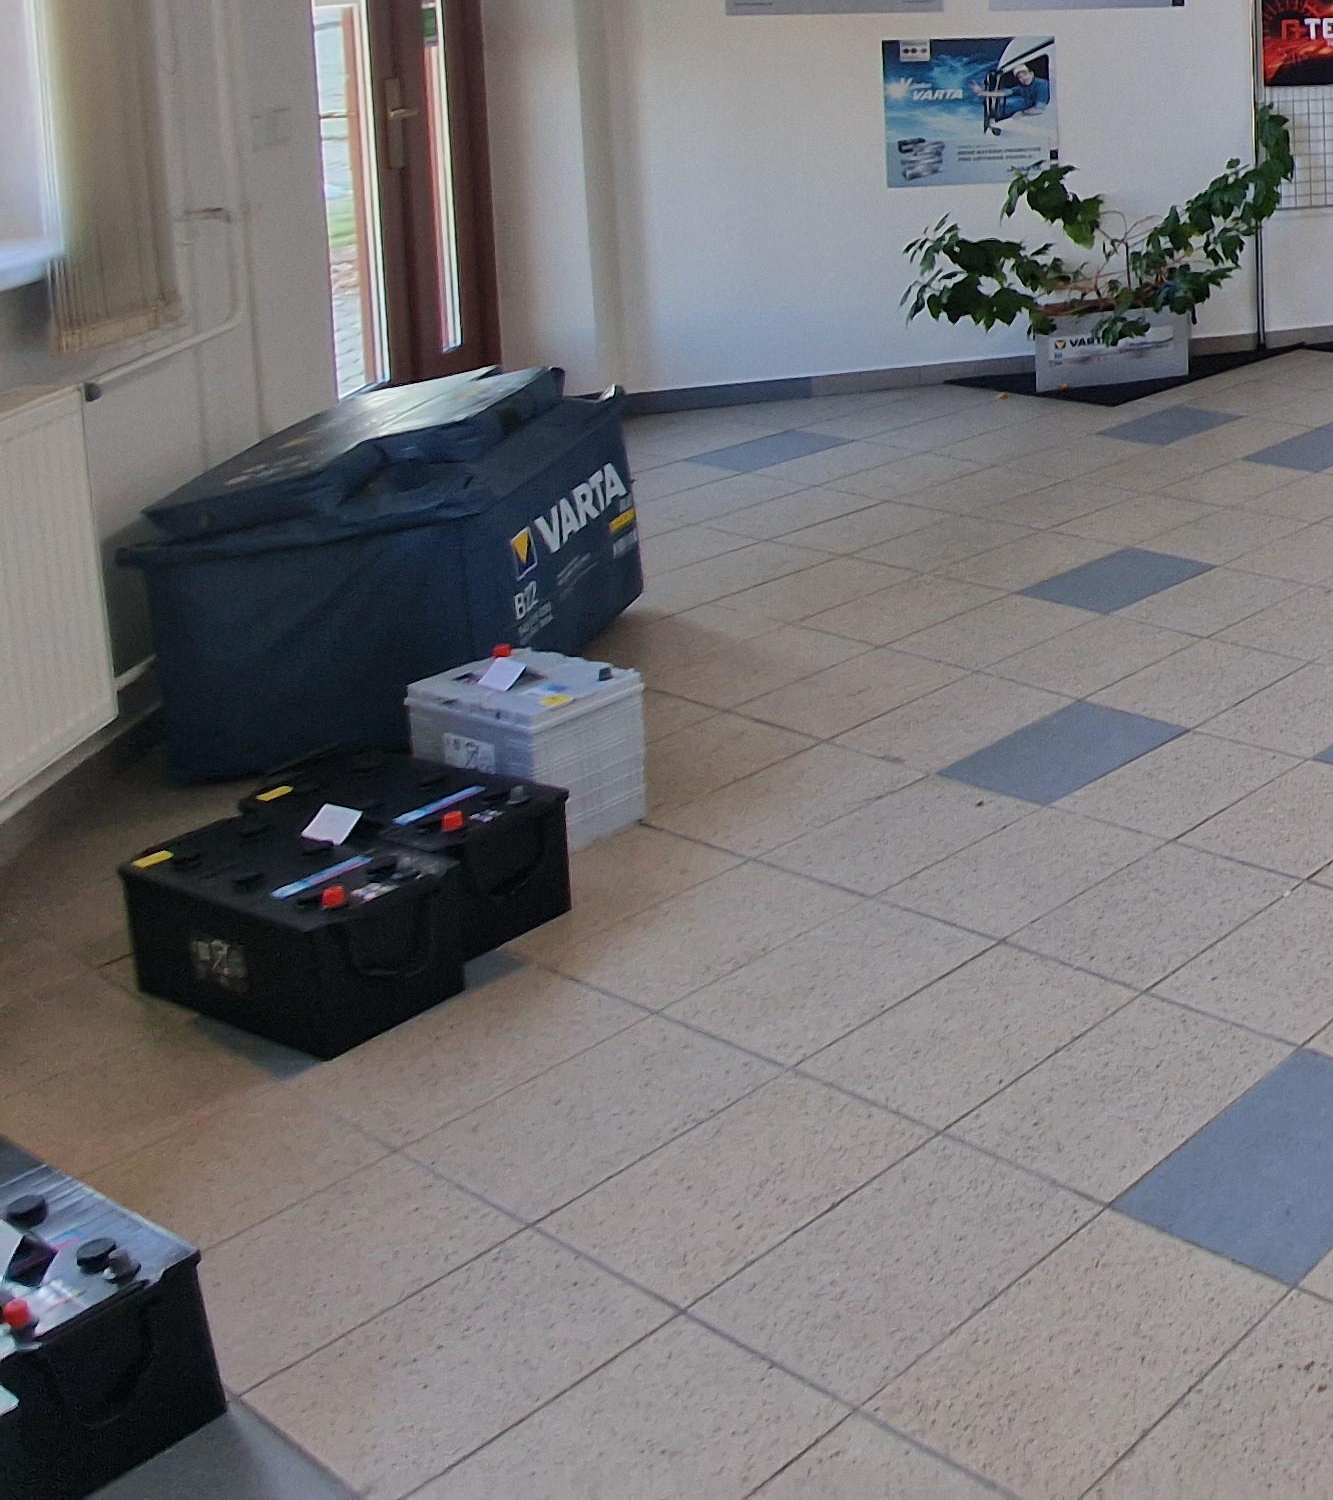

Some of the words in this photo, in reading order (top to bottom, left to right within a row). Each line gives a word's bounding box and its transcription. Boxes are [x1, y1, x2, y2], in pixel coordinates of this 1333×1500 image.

[912, 88, 965, 101] VARTA
[1069, 336, 1106, 348] VART
[534, 462, 627, 554] VARTA
